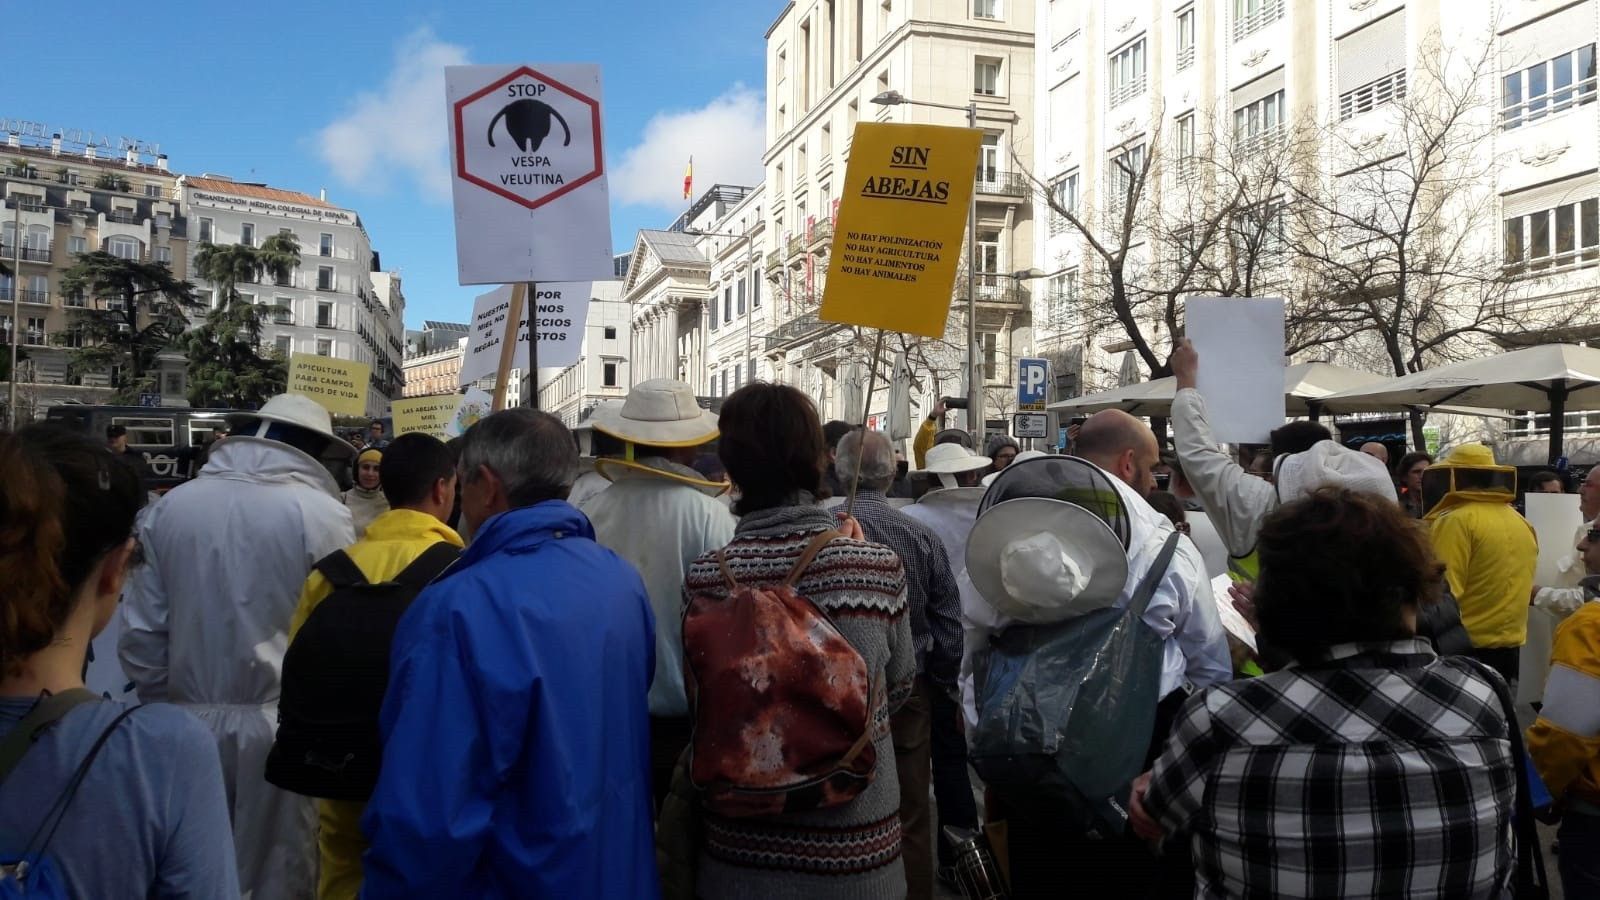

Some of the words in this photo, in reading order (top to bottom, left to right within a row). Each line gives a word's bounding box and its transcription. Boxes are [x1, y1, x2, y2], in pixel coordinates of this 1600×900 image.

[508, 84, 546, 97] STOP
[511, 156, 551, 167] VESPA
[890, 146, 930, 165] SIN
[500, 174, 564, 185] VELUTINA
[862, 176, 949, 199] ABEJAS
[277, 204, 312, 215] COLEGIAL
[324, 211, 349, 220] ESPAÑA
[847, 232, 859, 240] NO
[861, 233, 878, 241] HAY
[878, 235, 944, 250] POLINIZACIÓN
[858, 244, 876, 253] HAY
[876, 247, 940, 262] AGRICULTURA
[843, 254, 855, 262] NO
[856, 255, 874, 265] HAY
[874, 258, 926, 272] ALIMENTOS
[841, 265, 853, 273] NO
[854, 267, 872, 276] HAY
[872, 270, 917, 282] ANIMALES
[536, 291, 562, 299] POR
[477, 301, 509, 320] NUESTRA
[535, 304, 564, 313] NOS
[477, 320, 493, 331] MIEL
[494, 314, 505, 323] NO
[484, 329, 493, 338] SE
[473, 337, 500, 353] REGALA
[297, 363, 348, 376] APICULTURA
[295, 373, 317, 383] PARA
[320, 377, 354, 388] CAMPOS
[1027, 366, 1044, 394] P
[294, 384, 325, 394] LLENOS
[327, 388, 337, 396] DE
[340, 391, 360, 399] VIDA
